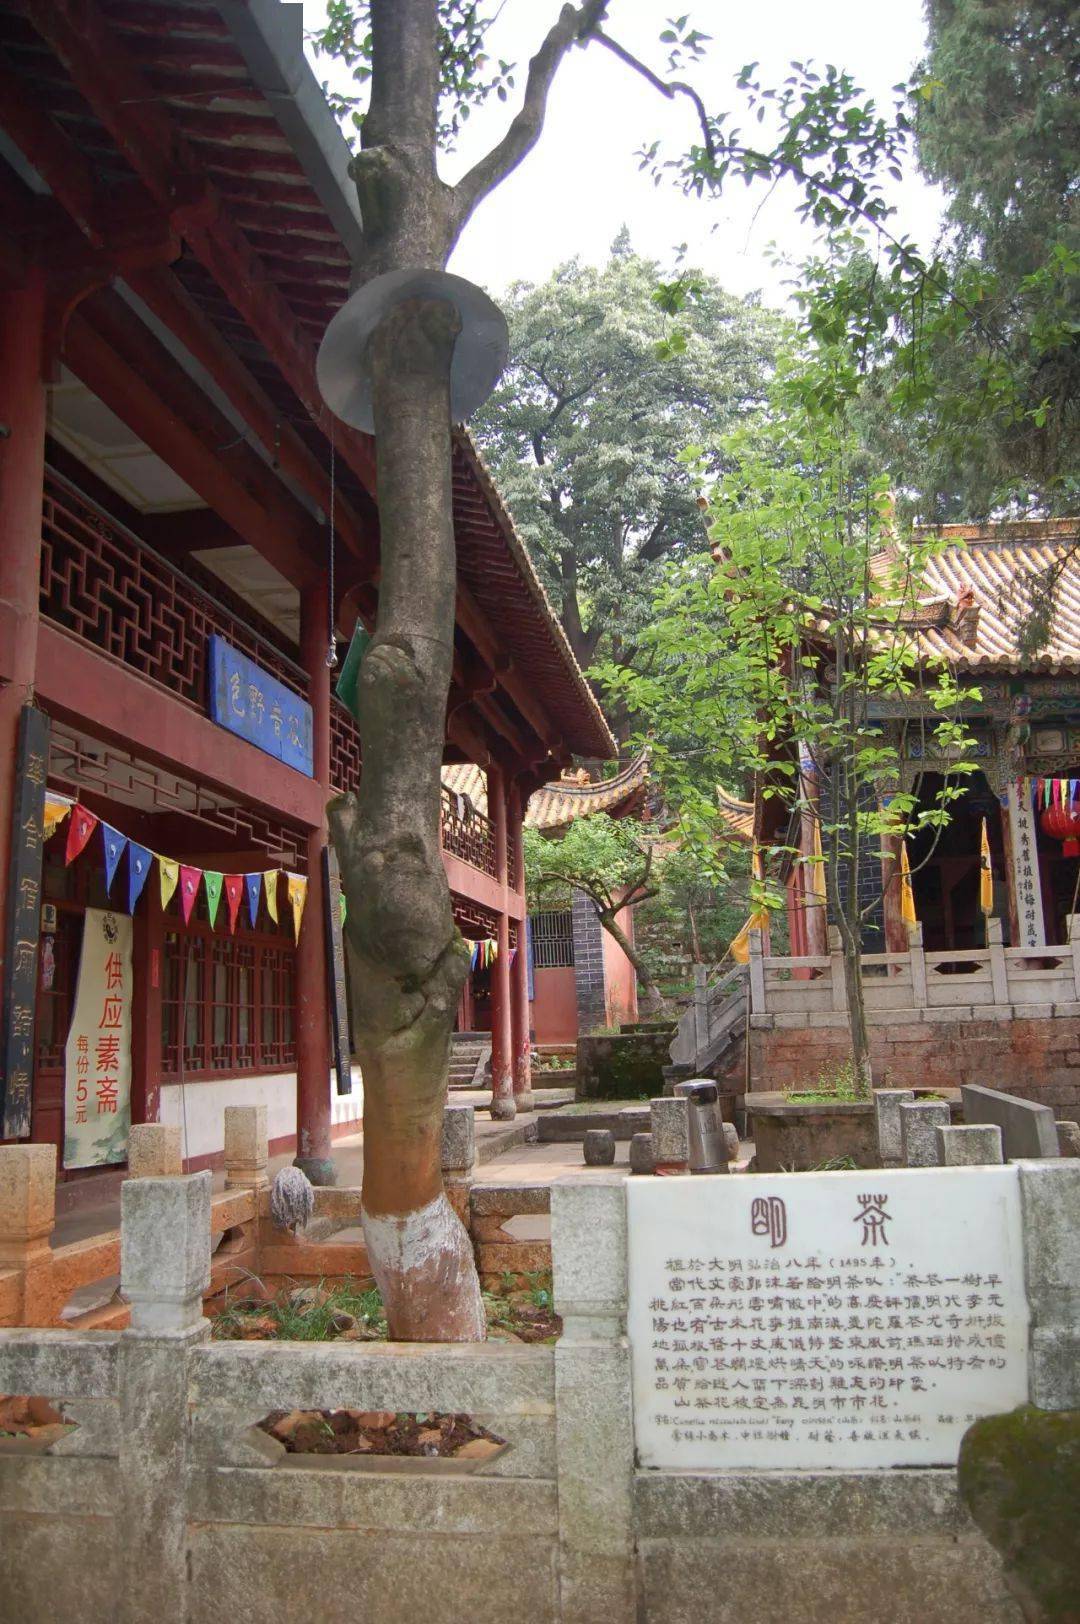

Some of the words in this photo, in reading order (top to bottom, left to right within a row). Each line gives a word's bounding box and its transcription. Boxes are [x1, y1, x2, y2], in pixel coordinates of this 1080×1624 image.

[75, 1034, 90, 1124] 每份5元
[94, 951, 123, 1114] 供应素斋
